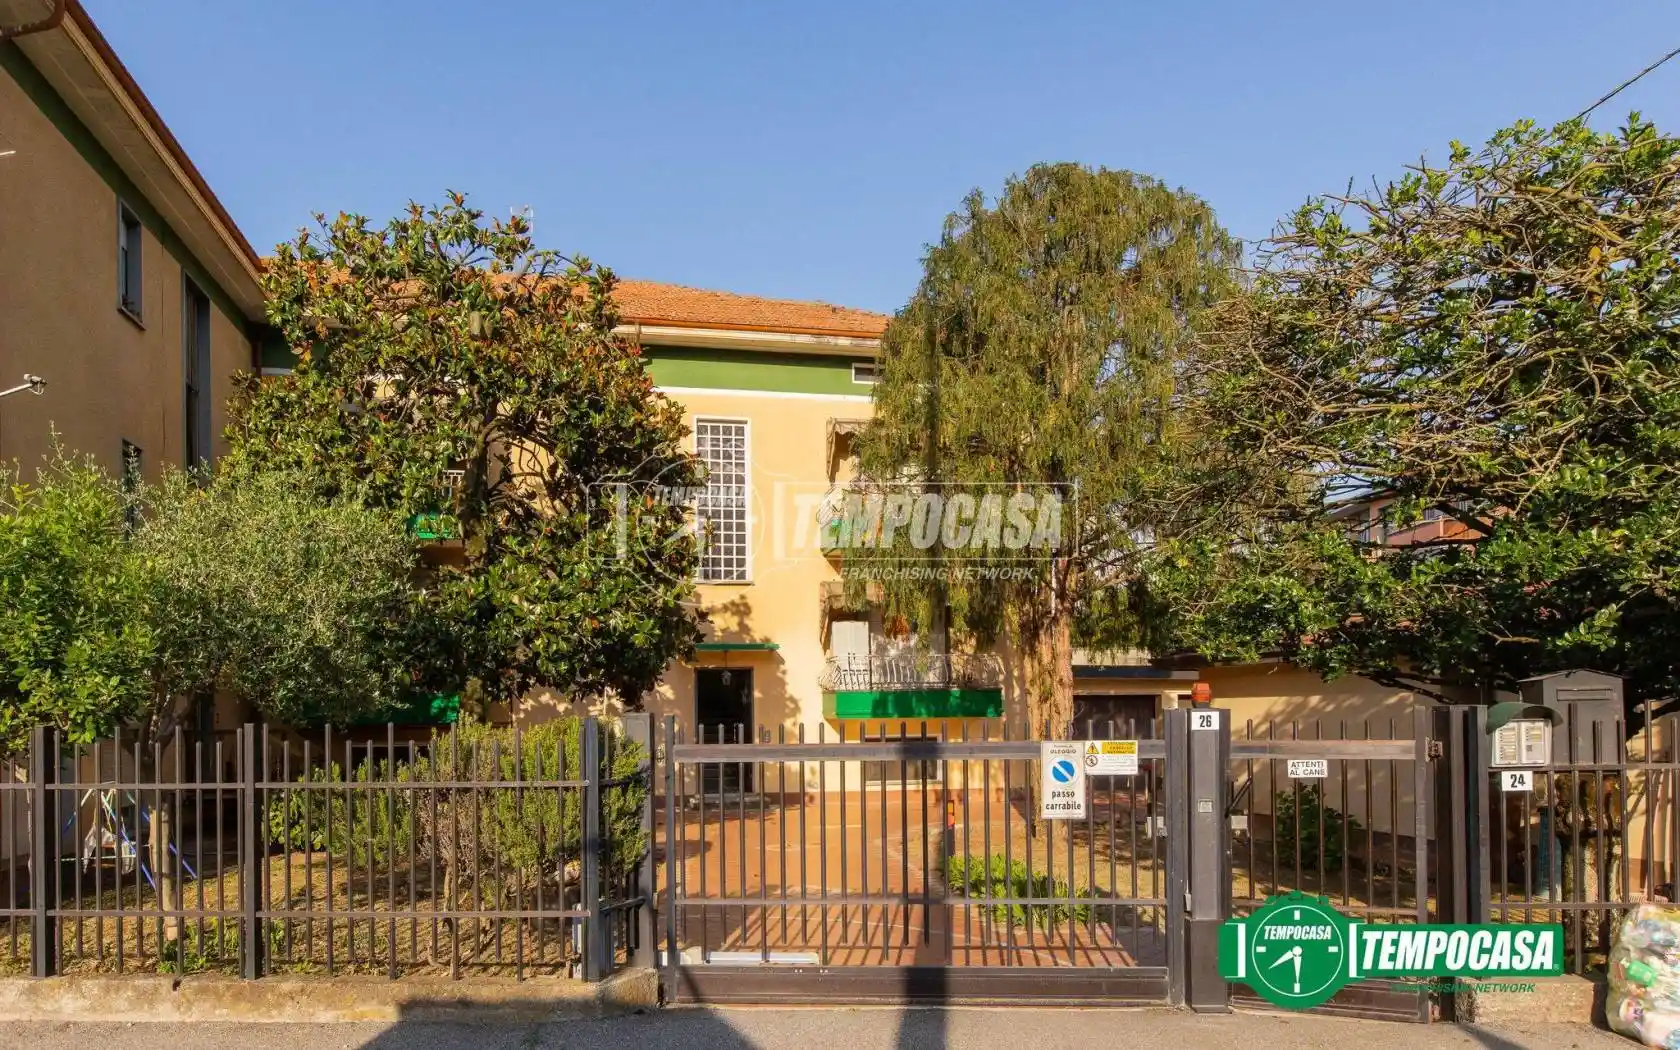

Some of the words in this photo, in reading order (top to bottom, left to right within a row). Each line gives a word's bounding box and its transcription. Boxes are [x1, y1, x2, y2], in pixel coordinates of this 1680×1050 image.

[1199, 715, 1212, 728] 26
[1510, 774, 1526, 788] 24
[1052, 791, 1075, 800] passo
[1045, 802, 1081, 810] carrabile
